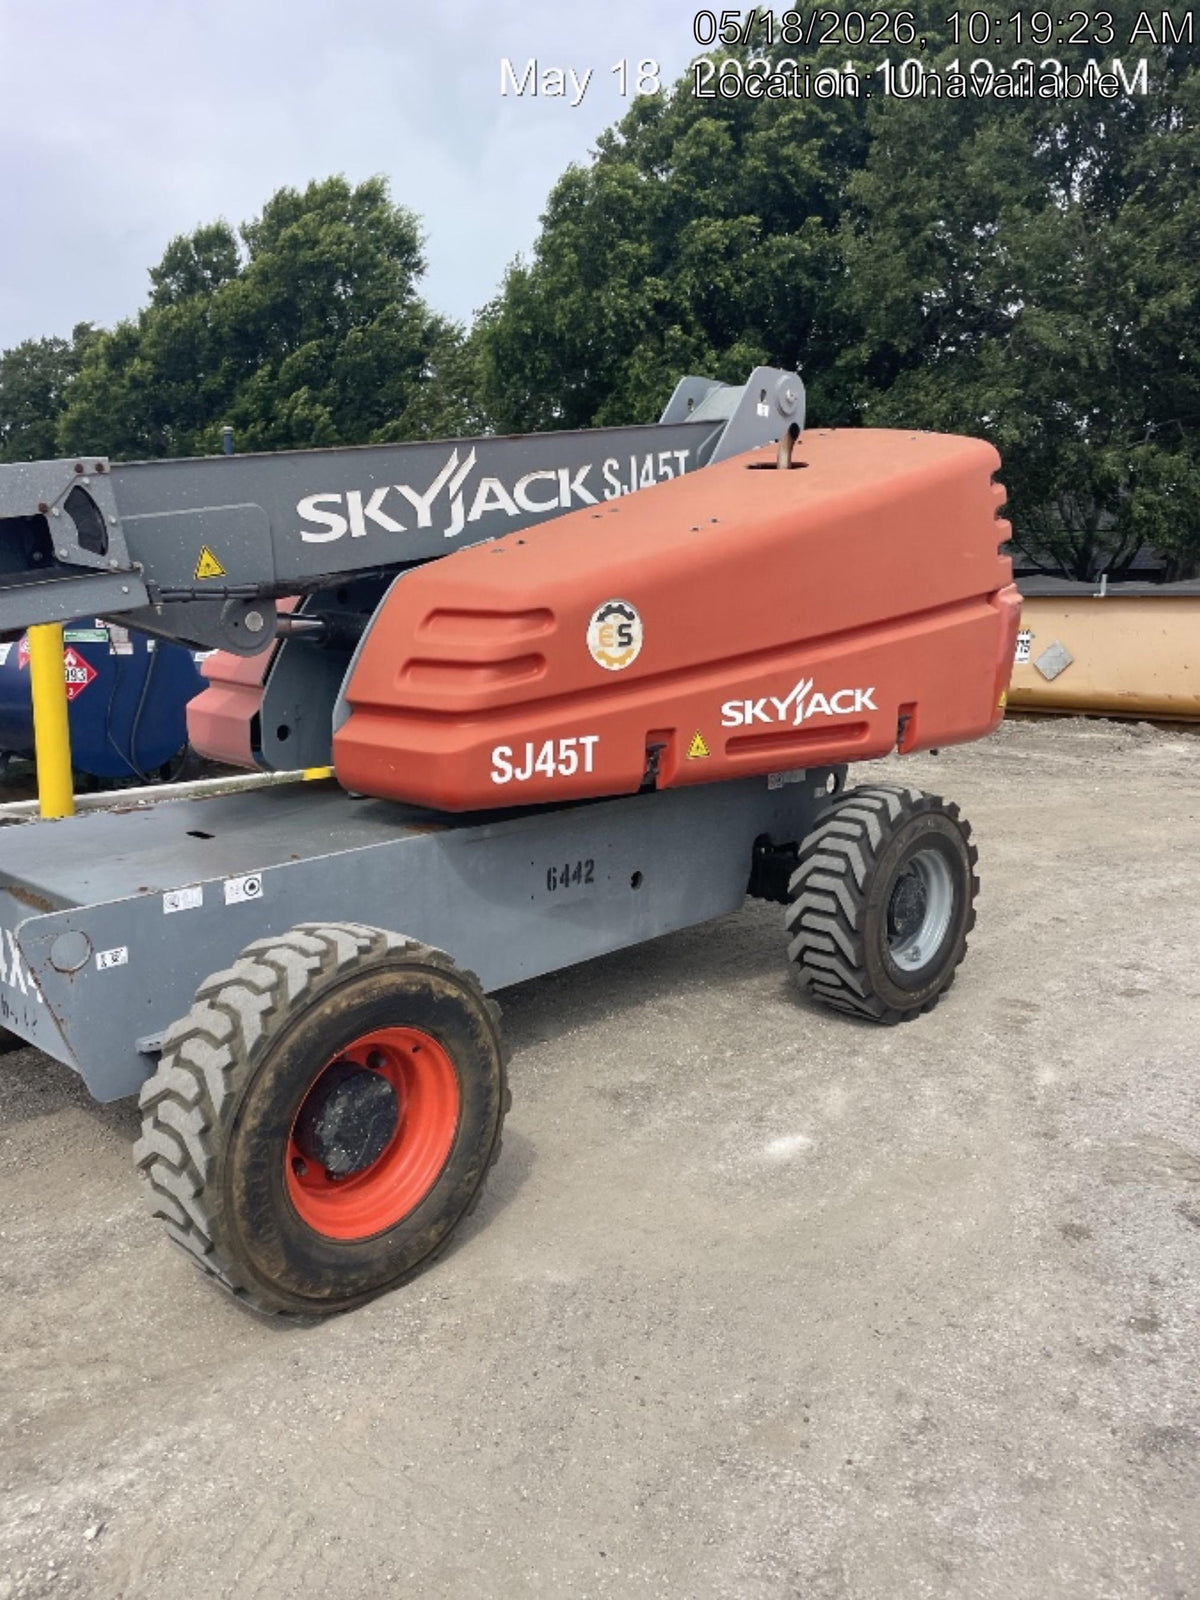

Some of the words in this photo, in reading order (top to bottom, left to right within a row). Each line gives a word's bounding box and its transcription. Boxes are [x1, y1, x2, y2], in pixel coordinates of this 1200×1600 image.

[296, 446, 600, 543] SKYJACK
[720, 677, 878, 727] SKYJACK
[489, 735, 599, 785] SJ45T
[546, 858, 595, 891] 6442
